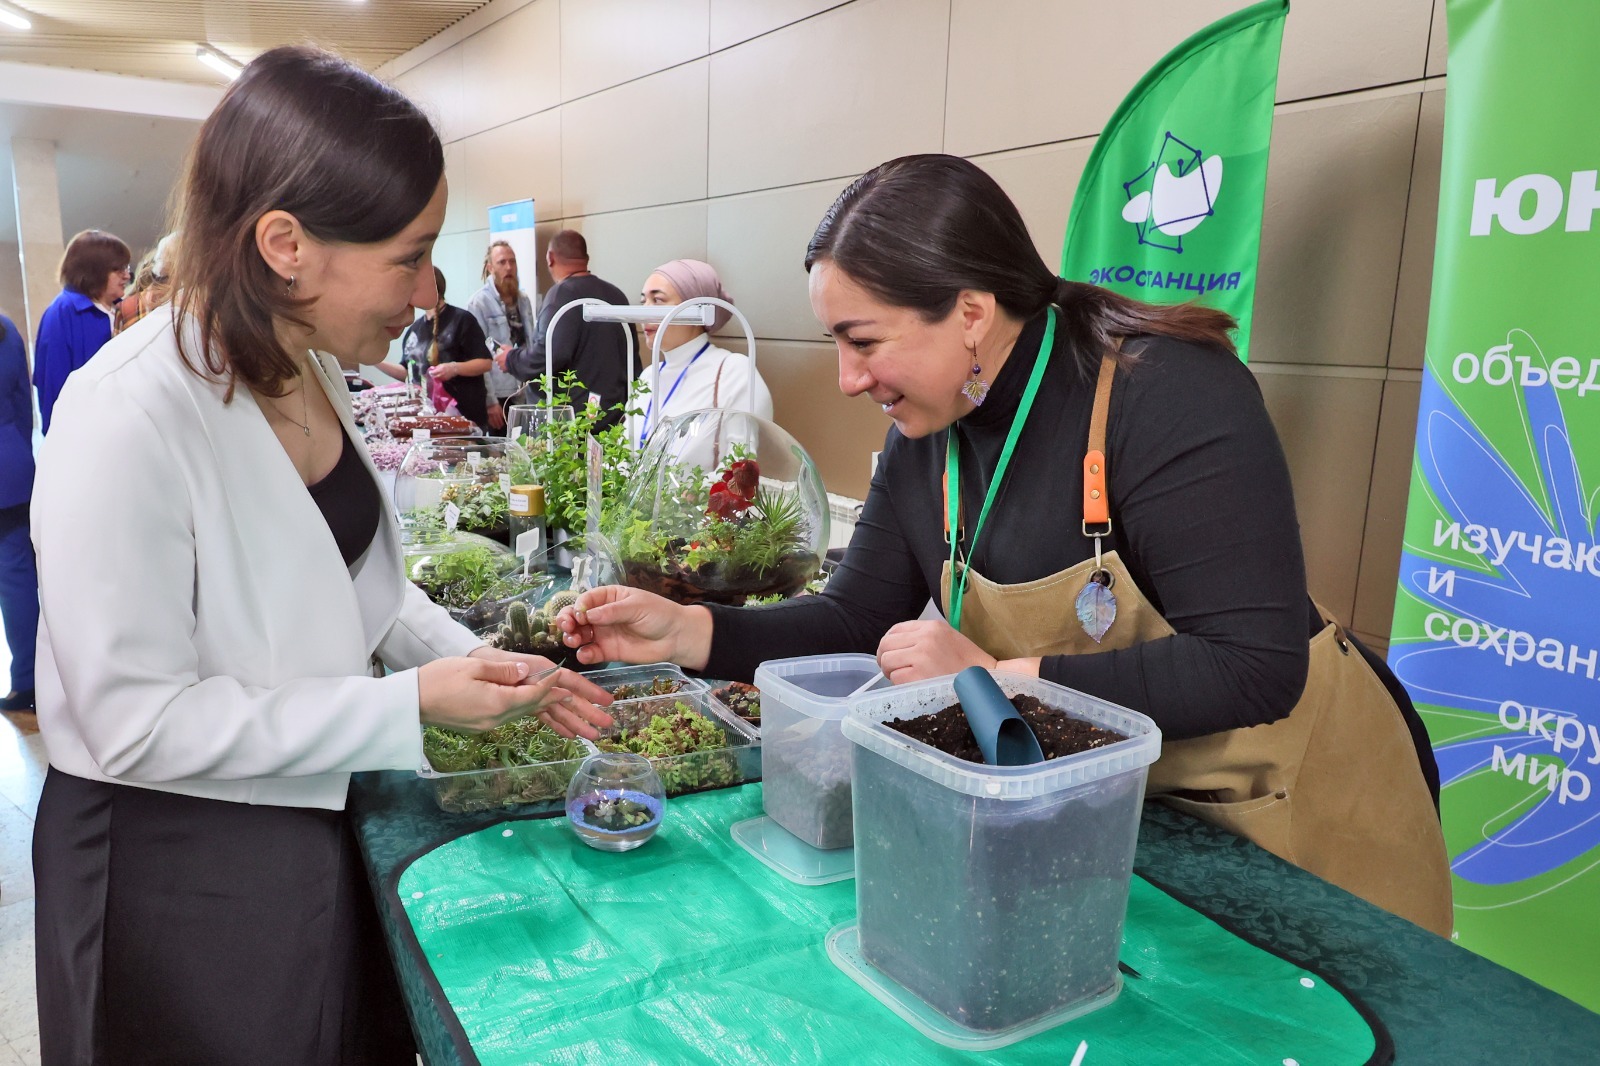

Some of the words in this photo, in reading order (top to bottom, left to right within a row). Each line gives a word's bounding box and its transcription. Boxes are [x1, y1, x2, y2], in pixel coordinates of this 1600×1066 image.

[1089, 265, 1241, 295] ЭКОСТАНЦИЯ
[1452, 343, 1600, 398] объед
[1433, 519, 1600, 578] изучаю
[1427, 566, 1456, 598] и
[1424, 611, 1600, 681] сохран
[1491, 744, 1592, 805] мир
